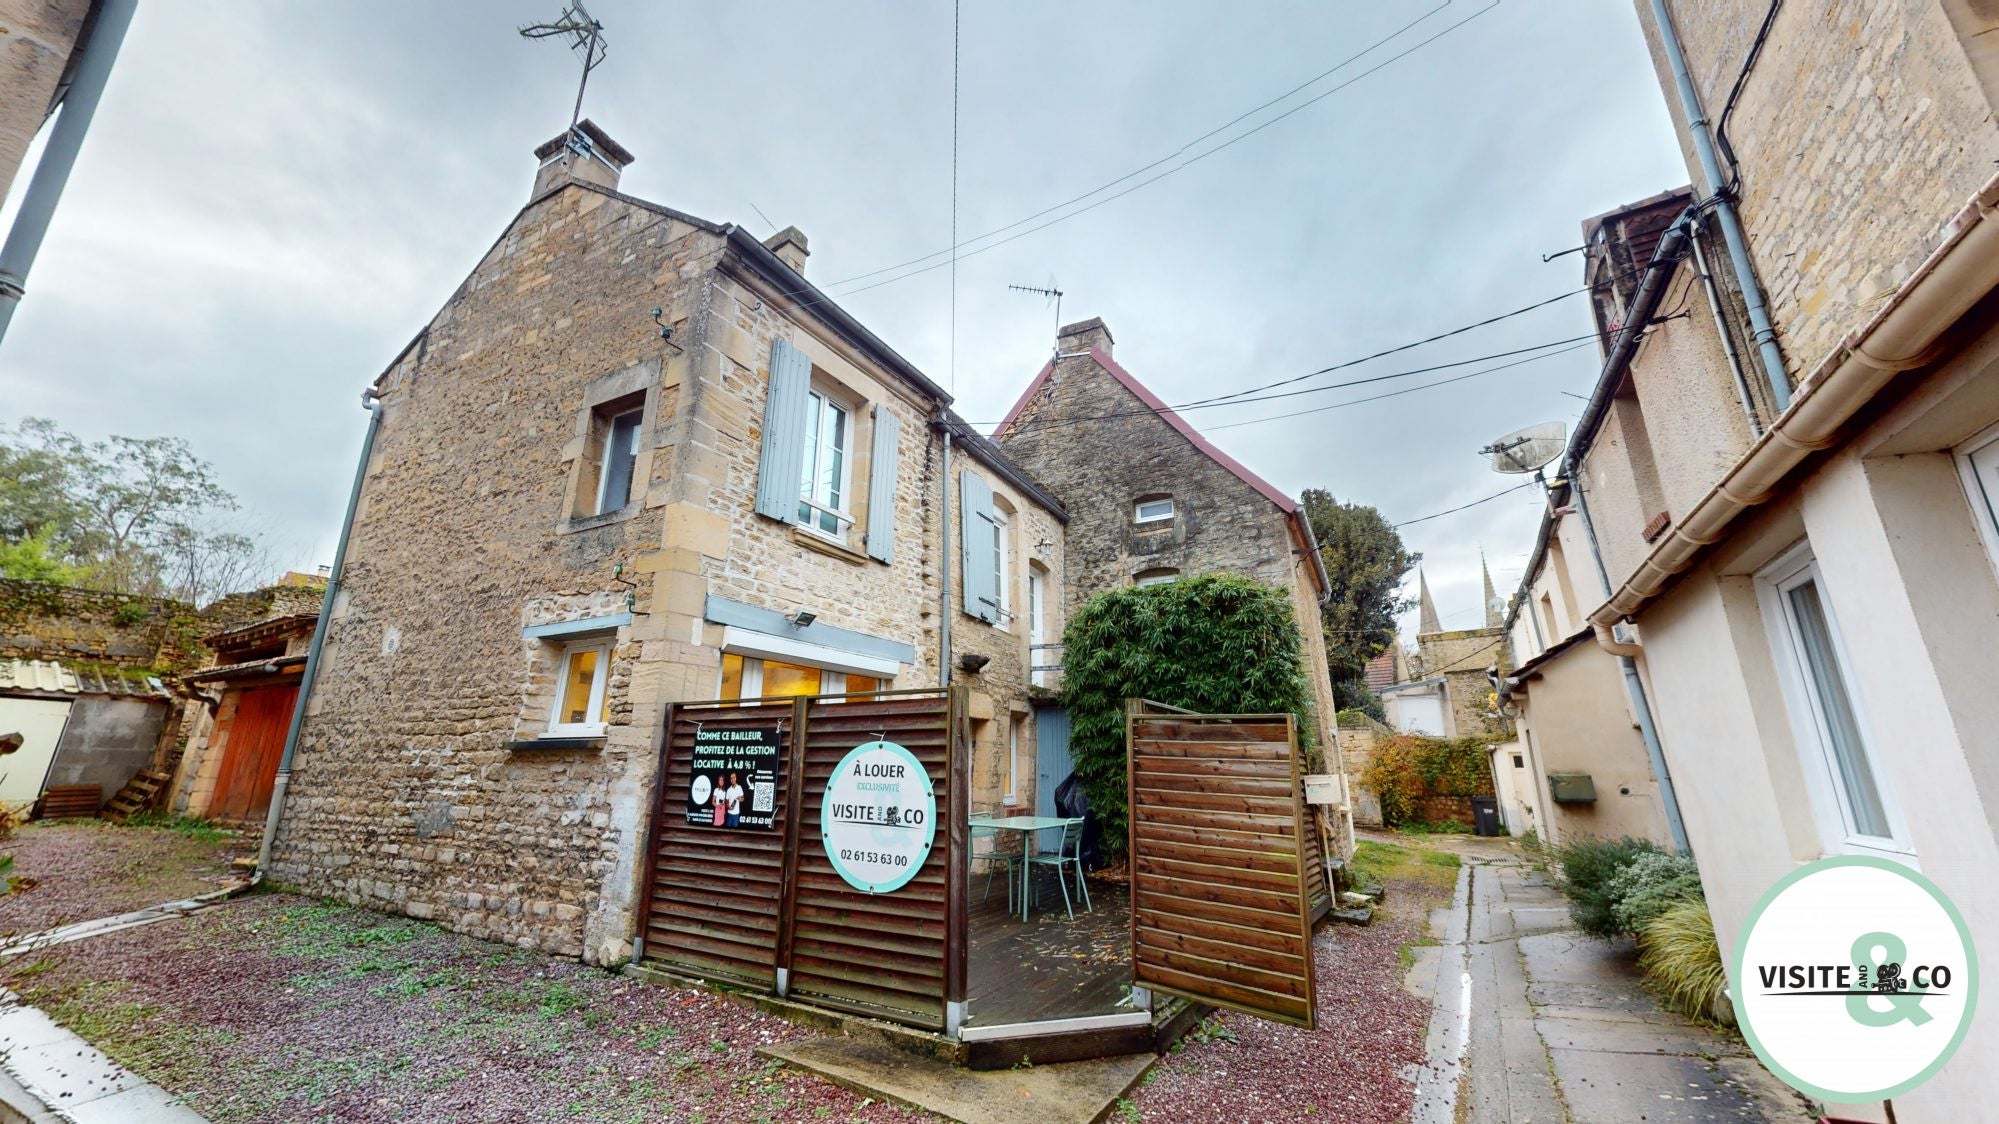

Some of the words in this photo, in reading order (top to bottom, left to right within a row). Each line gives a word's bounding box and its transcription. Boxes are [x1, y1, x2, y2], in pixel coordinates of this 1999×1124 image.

[697, 732, 720, 740] COMME
[721, 732, 730, 740] CE
[731, 731, 763, 741] BAILLEUR,
[695, 745, 725, 755] PROFITEZ
[726, 745, 735, 755] DE
[736, 745, 744, 755] LA
[745, 745, 776, 755] GESTION
[693, 759, 725, 769] LOCATIVE
[727, 758, 733, 769] À
[744, 760, 751, 770] %
[853, 760, 861, 776] À
[864, 764, 905, 778] LOUER
[857, 781, 900, 792] EXCLUSIVITÉ
[832, 804, 874, 821] VISITE
[904, 808, 924, 825] CO
[841, 849, 851, 860] 02
[854, 850, 865, 862] 61
[867, 852, 878, 864] 53
[880, 853, 892, 865] 63
[895, 855, 907, 867] 00
